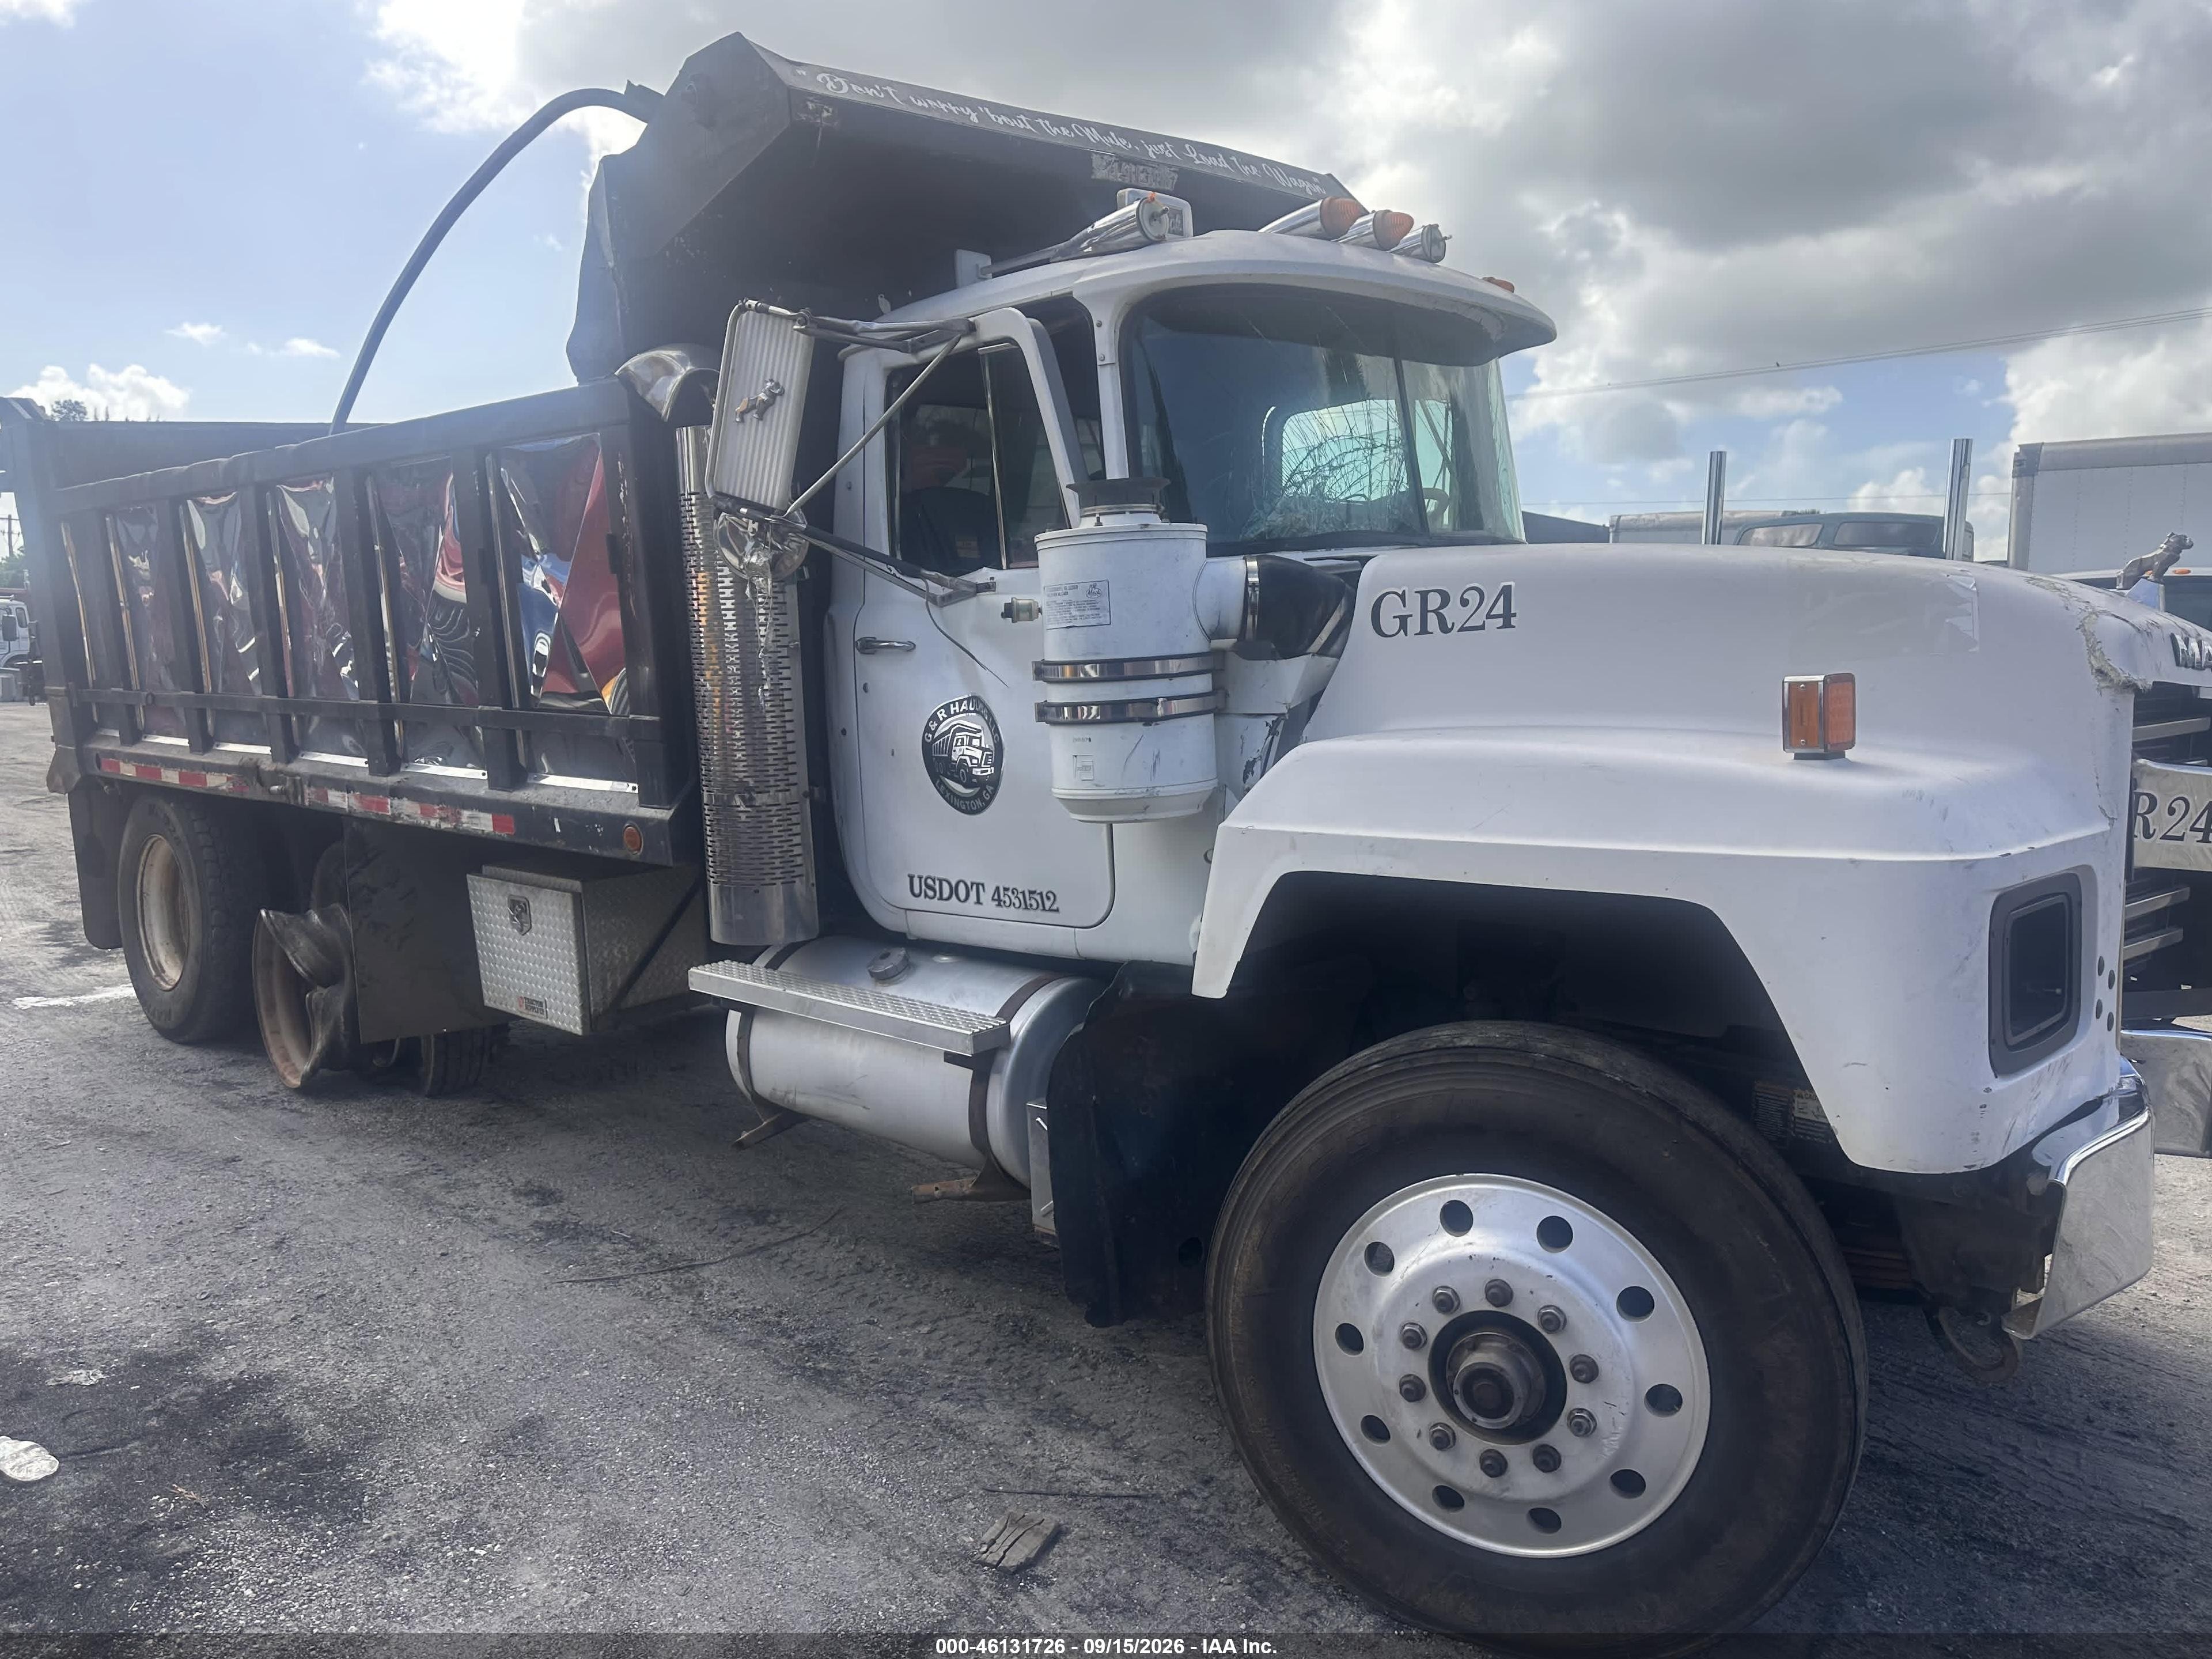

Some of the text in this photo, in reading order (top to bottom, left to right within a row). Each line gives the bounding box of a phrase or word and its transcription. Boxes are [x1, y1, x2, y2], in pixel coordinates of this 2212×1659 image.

[1140, 139, 1183, 161] just
[1370, 584, 1517, 638] GR24
[936, 708, 948, 721] R
[907, 873, 1060, 913] USDOT 4531512
